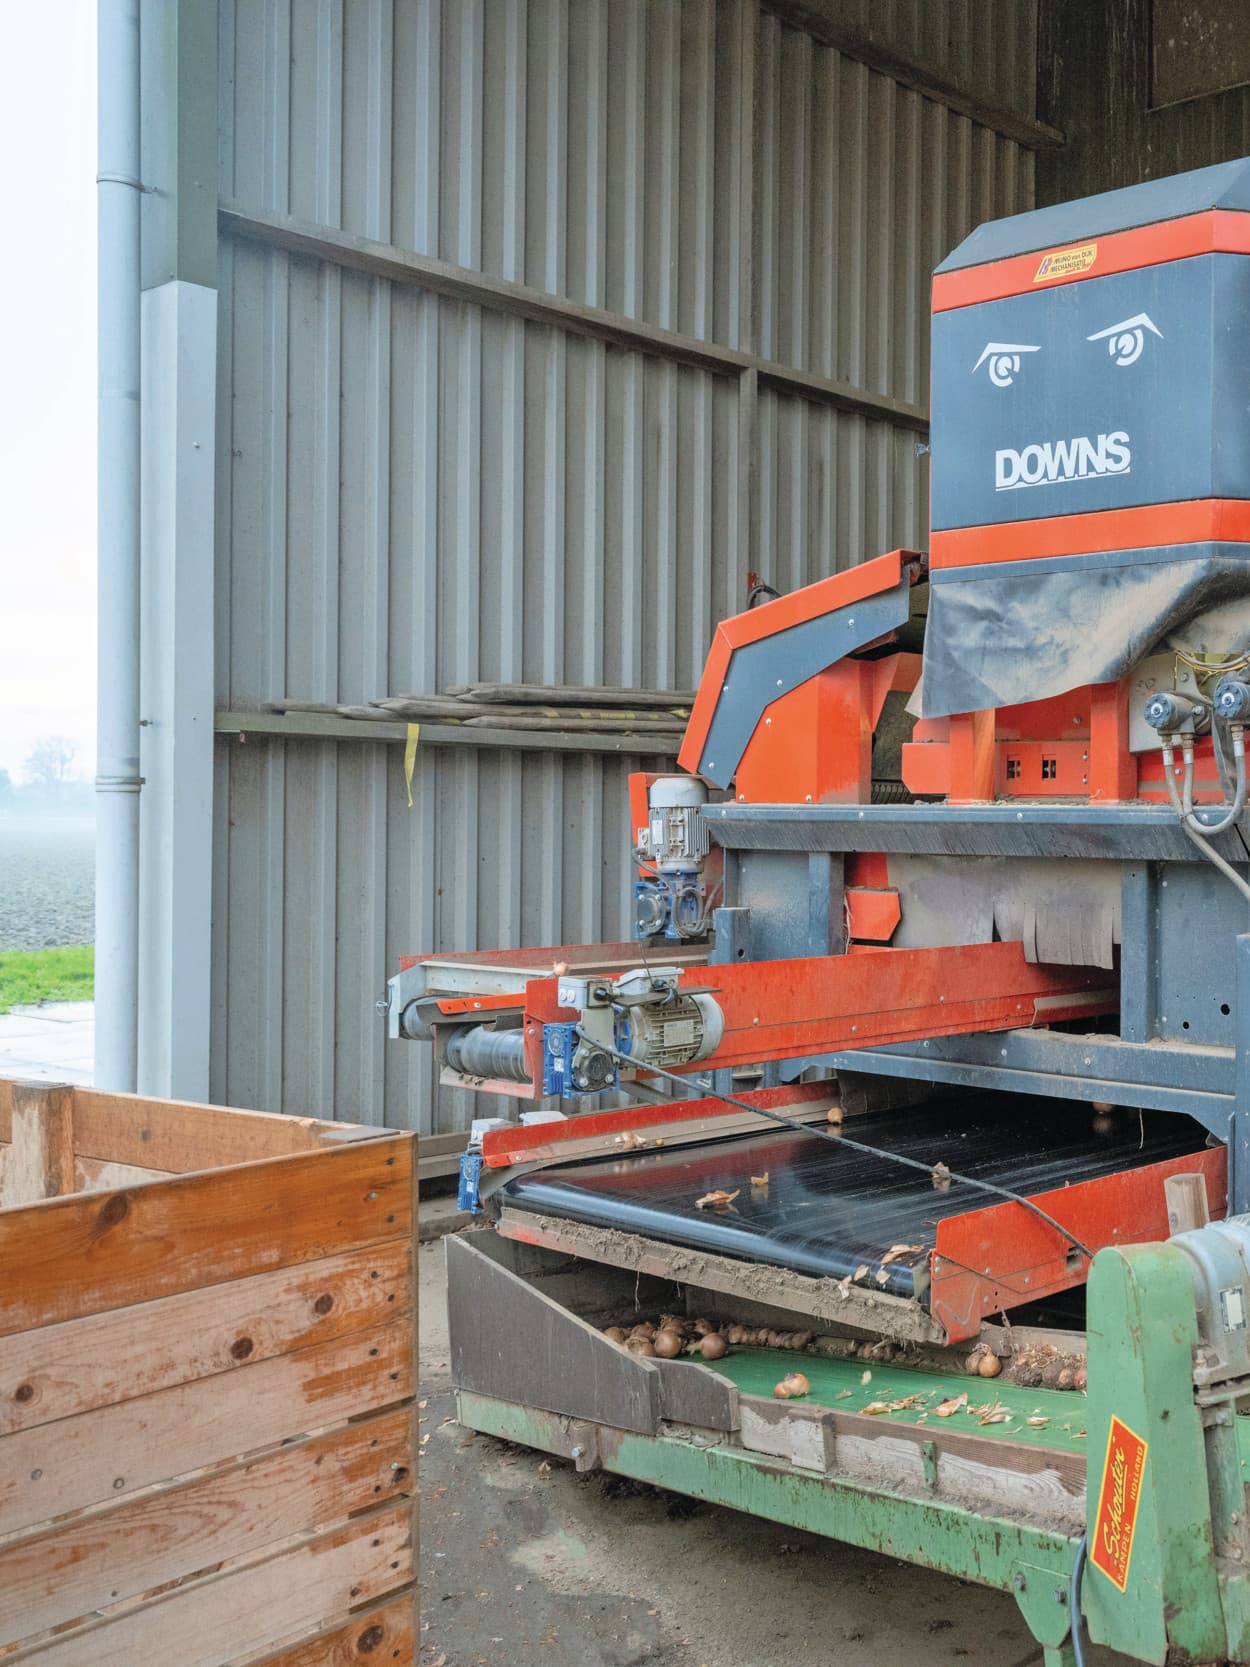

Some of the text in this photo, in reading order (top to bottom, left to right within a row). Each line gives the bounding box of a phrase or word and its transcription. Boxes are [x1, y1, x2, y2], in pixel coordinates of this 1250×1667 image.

[995, 431, 1131, 489] DOWNS
[1130, 1446, 1144, 1501] HOLLAND
[1116, 1522, 1132, 1583] KAMPEN
